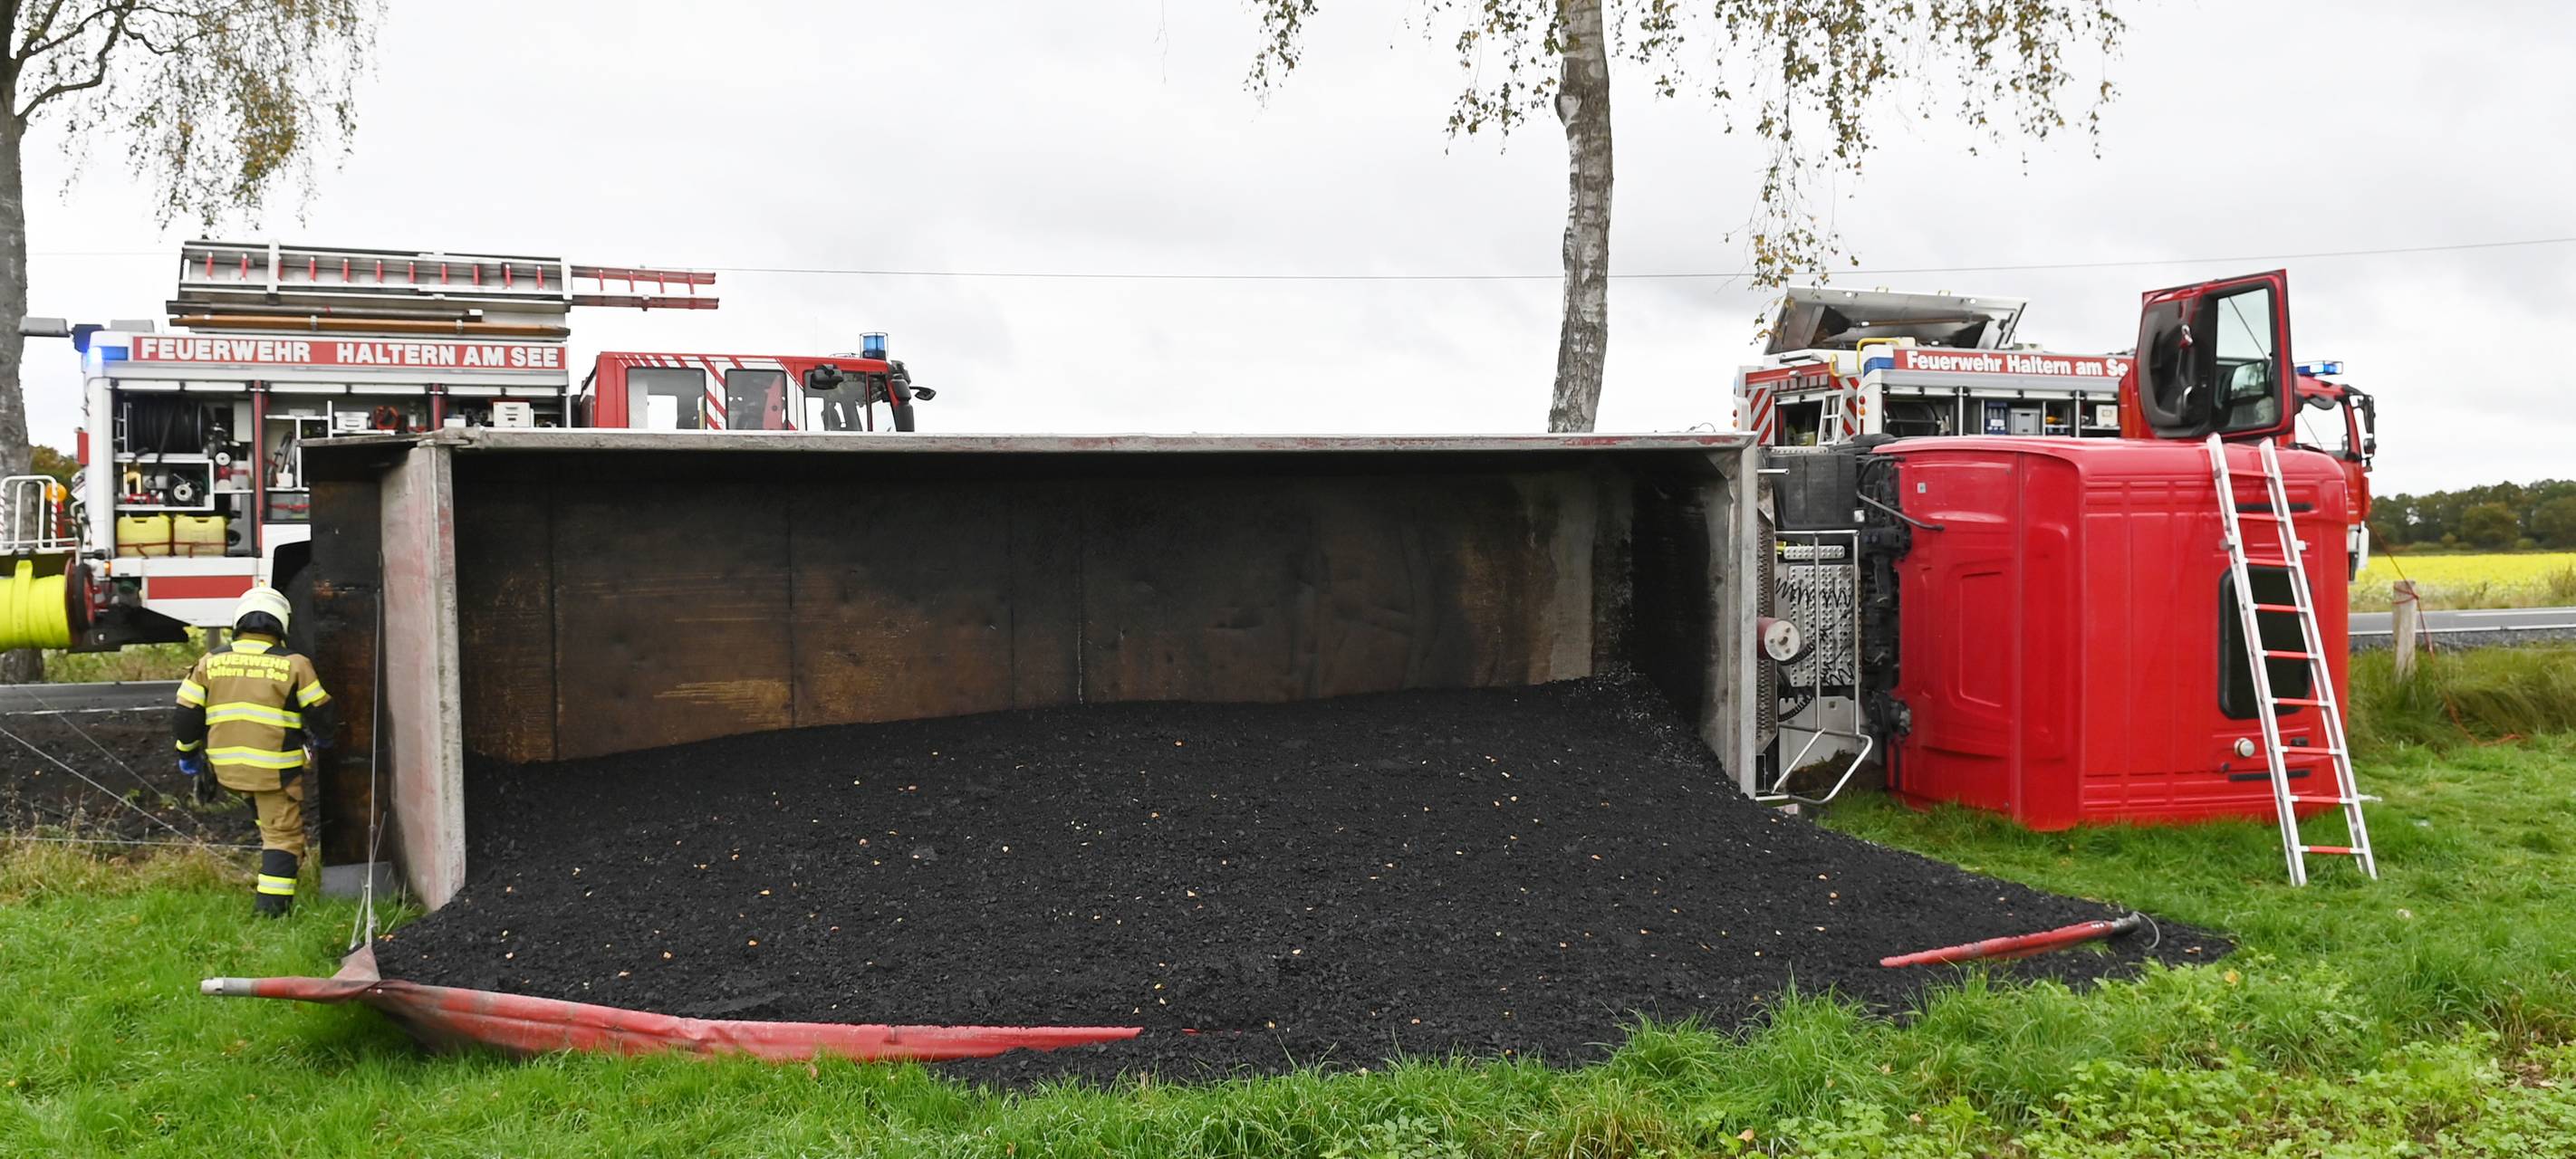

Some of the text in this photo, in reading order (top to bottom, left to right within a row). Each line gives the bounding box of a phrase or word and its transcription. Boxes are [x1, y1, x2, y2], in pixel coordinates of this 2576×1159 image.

[141, 338, 559, 368] FEUERWEHR HALTERN AM SEE
[1906, 350, 2129, 378] Feuerwehr Haltern am Se
[207, 654, 290, 670] FEUERWEHR
[245, 668, 265, 678] am
[265, 667, 289, 682] See
